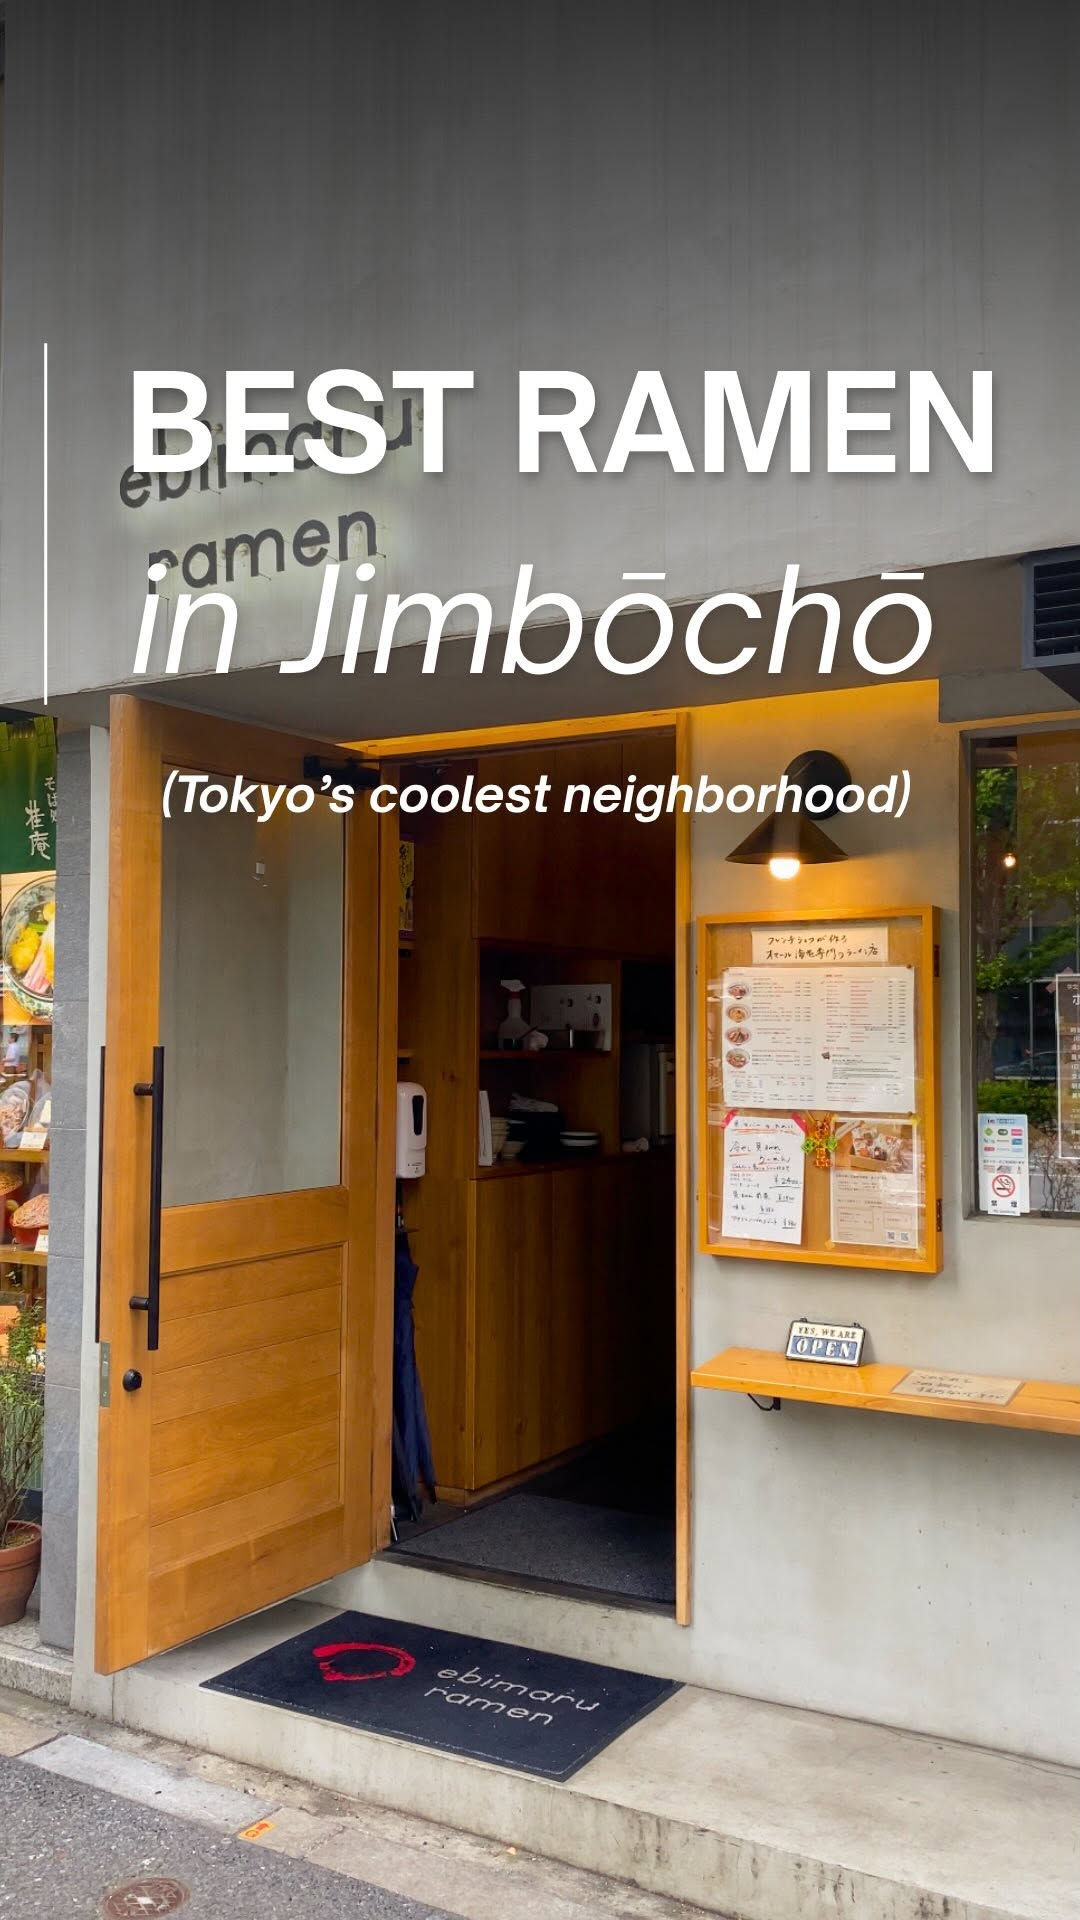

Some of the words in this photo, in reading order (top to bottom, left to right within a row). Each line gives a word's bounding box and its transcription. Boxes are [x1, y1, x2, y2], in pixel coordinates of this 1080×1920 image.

[148, 511, 377, 598] ramen
[796, 1338, 854, 1358] OPEN
[821, 1328, 836, 1338] WE
[837, 1331, 857, 1339] ARE
[424, 1687, 553, 1725] ramen
[437, 1666, 600, 1712] ebimaru
